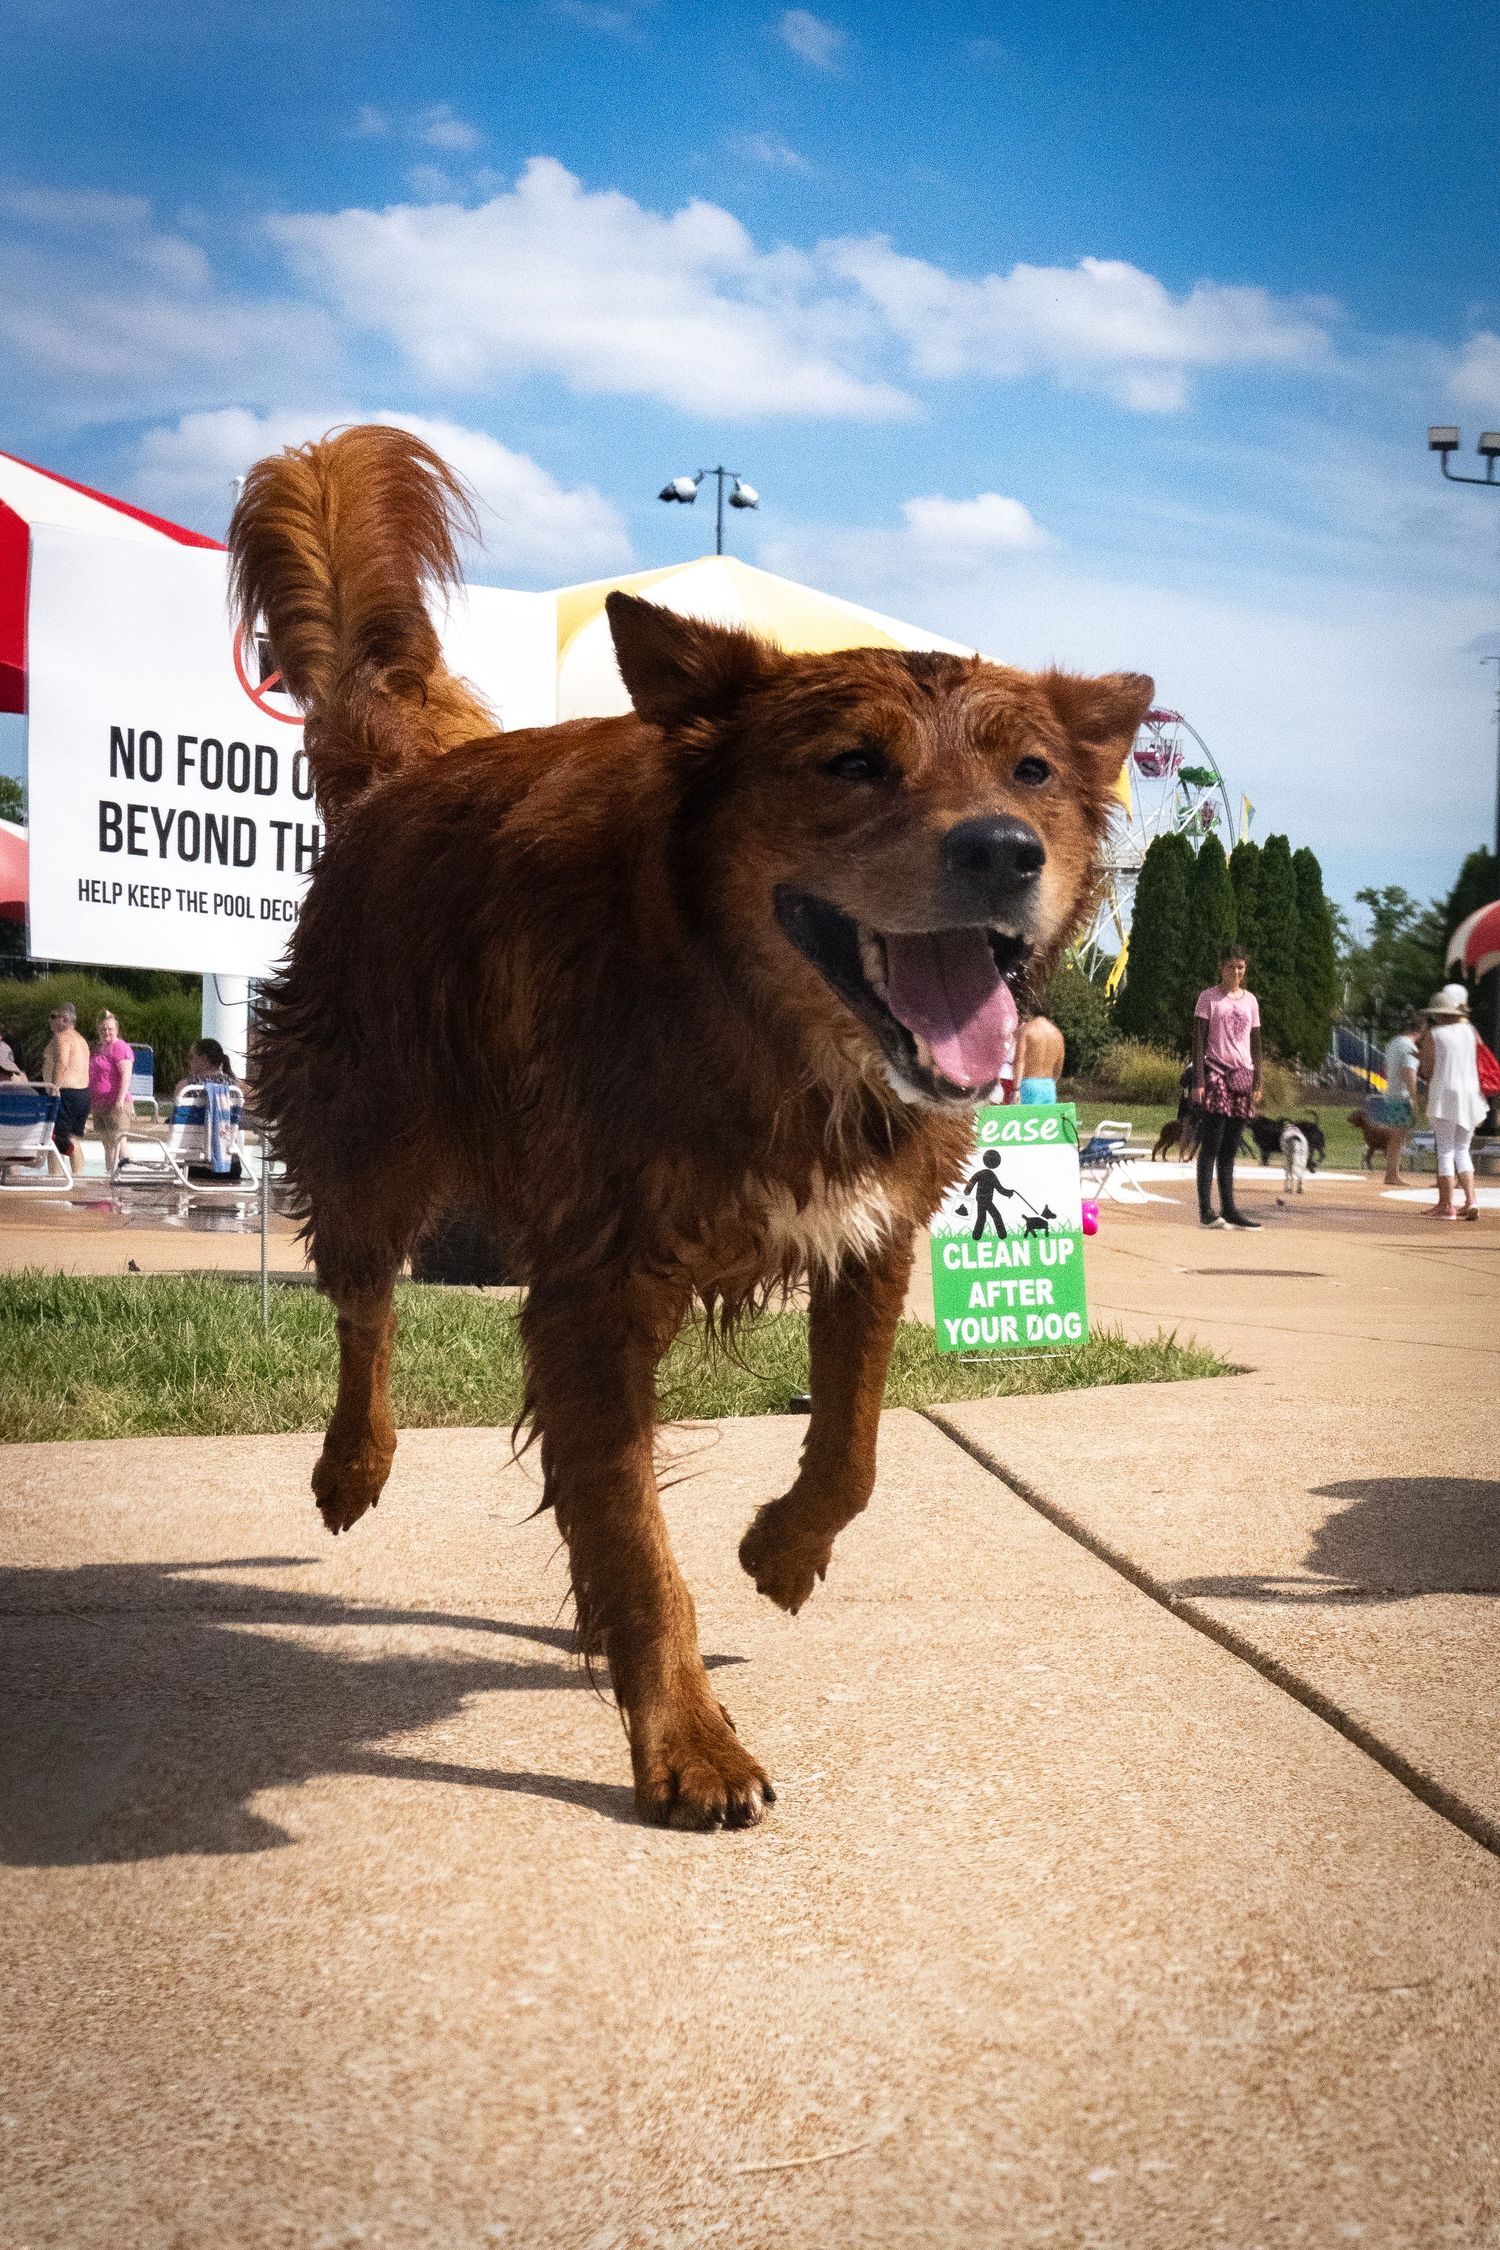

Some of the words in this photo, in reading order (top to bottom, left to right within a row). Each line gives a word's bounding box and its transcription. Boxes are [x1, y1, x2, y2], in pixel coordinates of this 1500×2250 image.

[109, 725, 163, 783] NO
[177, 734, 278, 797] FOOD
[98, 799, 257, 868] BEYOND
[269, 820, 320, 874] TH
[78, 878, 123, 905] HELP
[128, 883, 172, 911] KEEP
[176, 888, 208, 914] THE
[213, 893, 255, 919] POOL
[975, 1117, 1060, 1143] ease
[942, 1239, 1031, 1270] CLEAN
[1038, 1238, 1075, 1266] UP
[968, 1278, 1055, 1309] AFTER
[943, 1314, 1020, 1345] YOUR
[1026, 1311, 1083, 1342] DOG
